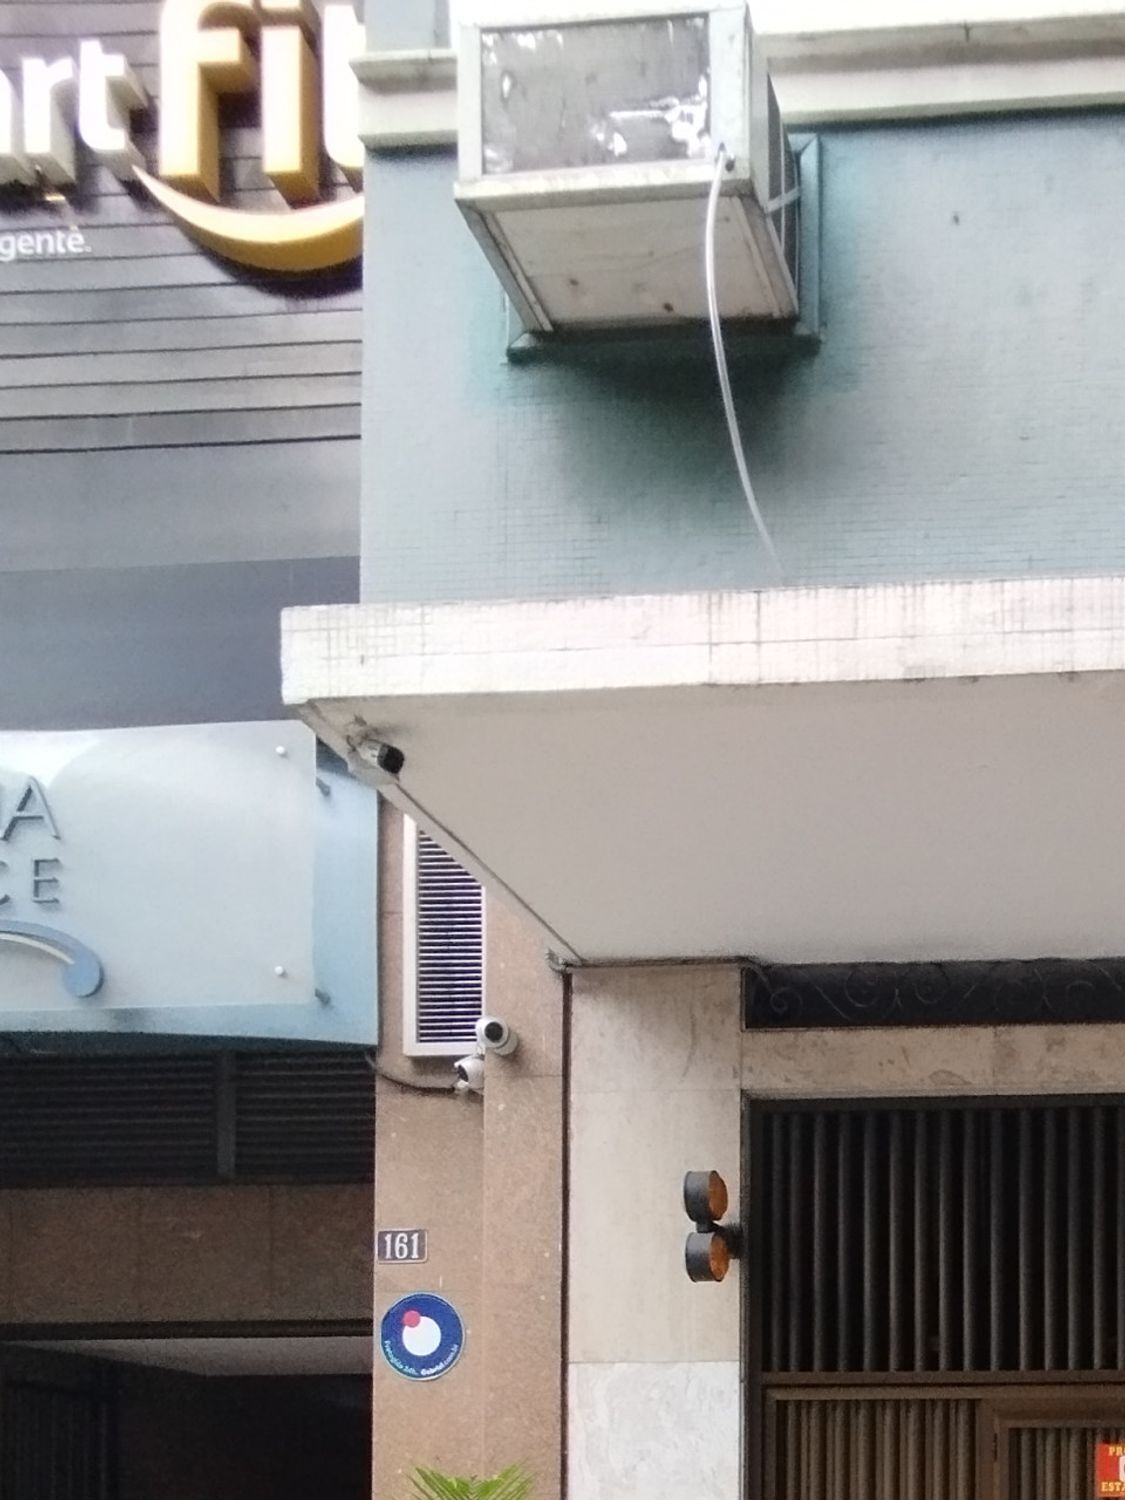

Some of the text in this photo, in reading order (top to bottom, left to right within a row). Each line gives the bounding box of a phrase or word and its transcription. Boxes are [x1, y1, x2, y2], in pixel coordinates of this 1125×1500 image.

[0, 0, 365, 181] rt fit
[384, 1232, 420, 1259] 161
